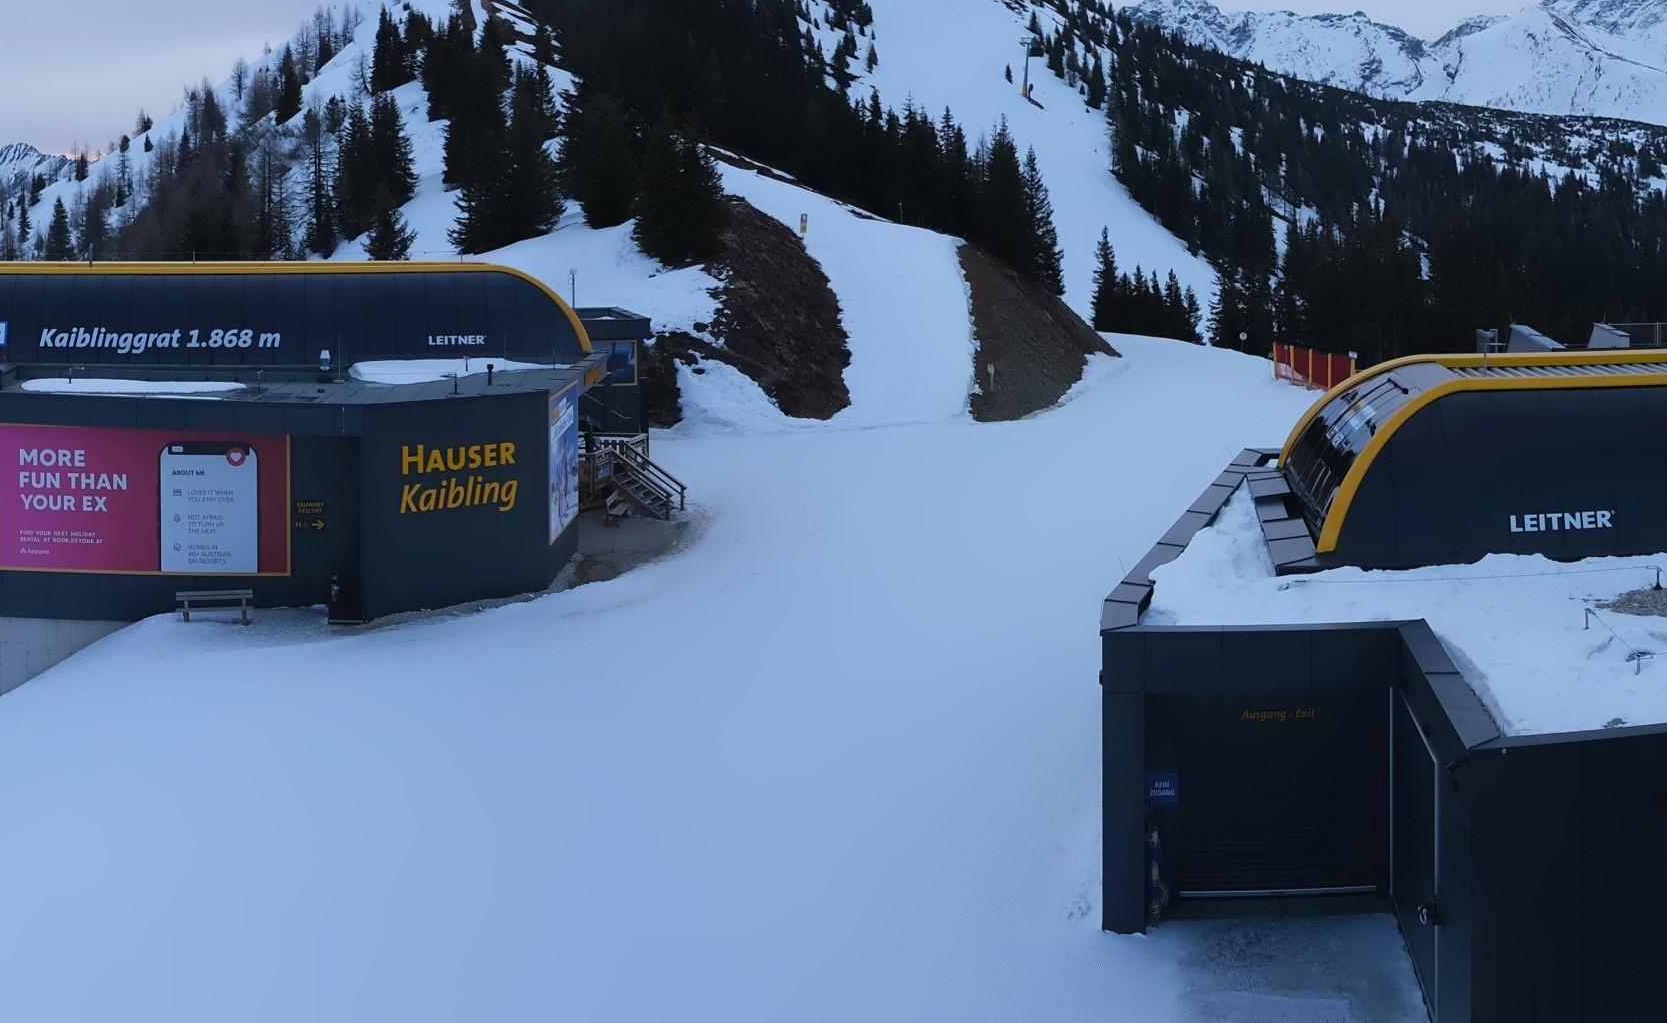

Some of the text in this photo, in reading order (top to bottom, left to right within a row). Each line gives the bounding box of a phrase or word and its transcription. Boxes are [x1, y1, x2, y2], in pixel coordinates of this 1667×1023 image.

[39, 327, 281, 354] Kaiblinggrat 1.868 m
[428, 335, 485, 346] LEITNER
[19, 448, 86, 467] MORE
[401, 442, 516, 475] HAUSER
[19, 471, 127, 490] FUN THAN
[20, 494, 108, 512] YOUR EX
[400, 476, 518, 513] Kaibling
[1510, 510, 1613, 533] LEITNER
[27, 548, 50, 556] keyone
[1242, 709, 1287, 721] Ausgang
[1296, 708, 1315, 718] Exit
[1150, 789, 1175, 797] ZUGANG
[1154, 781, 1170, 789] KEIN
